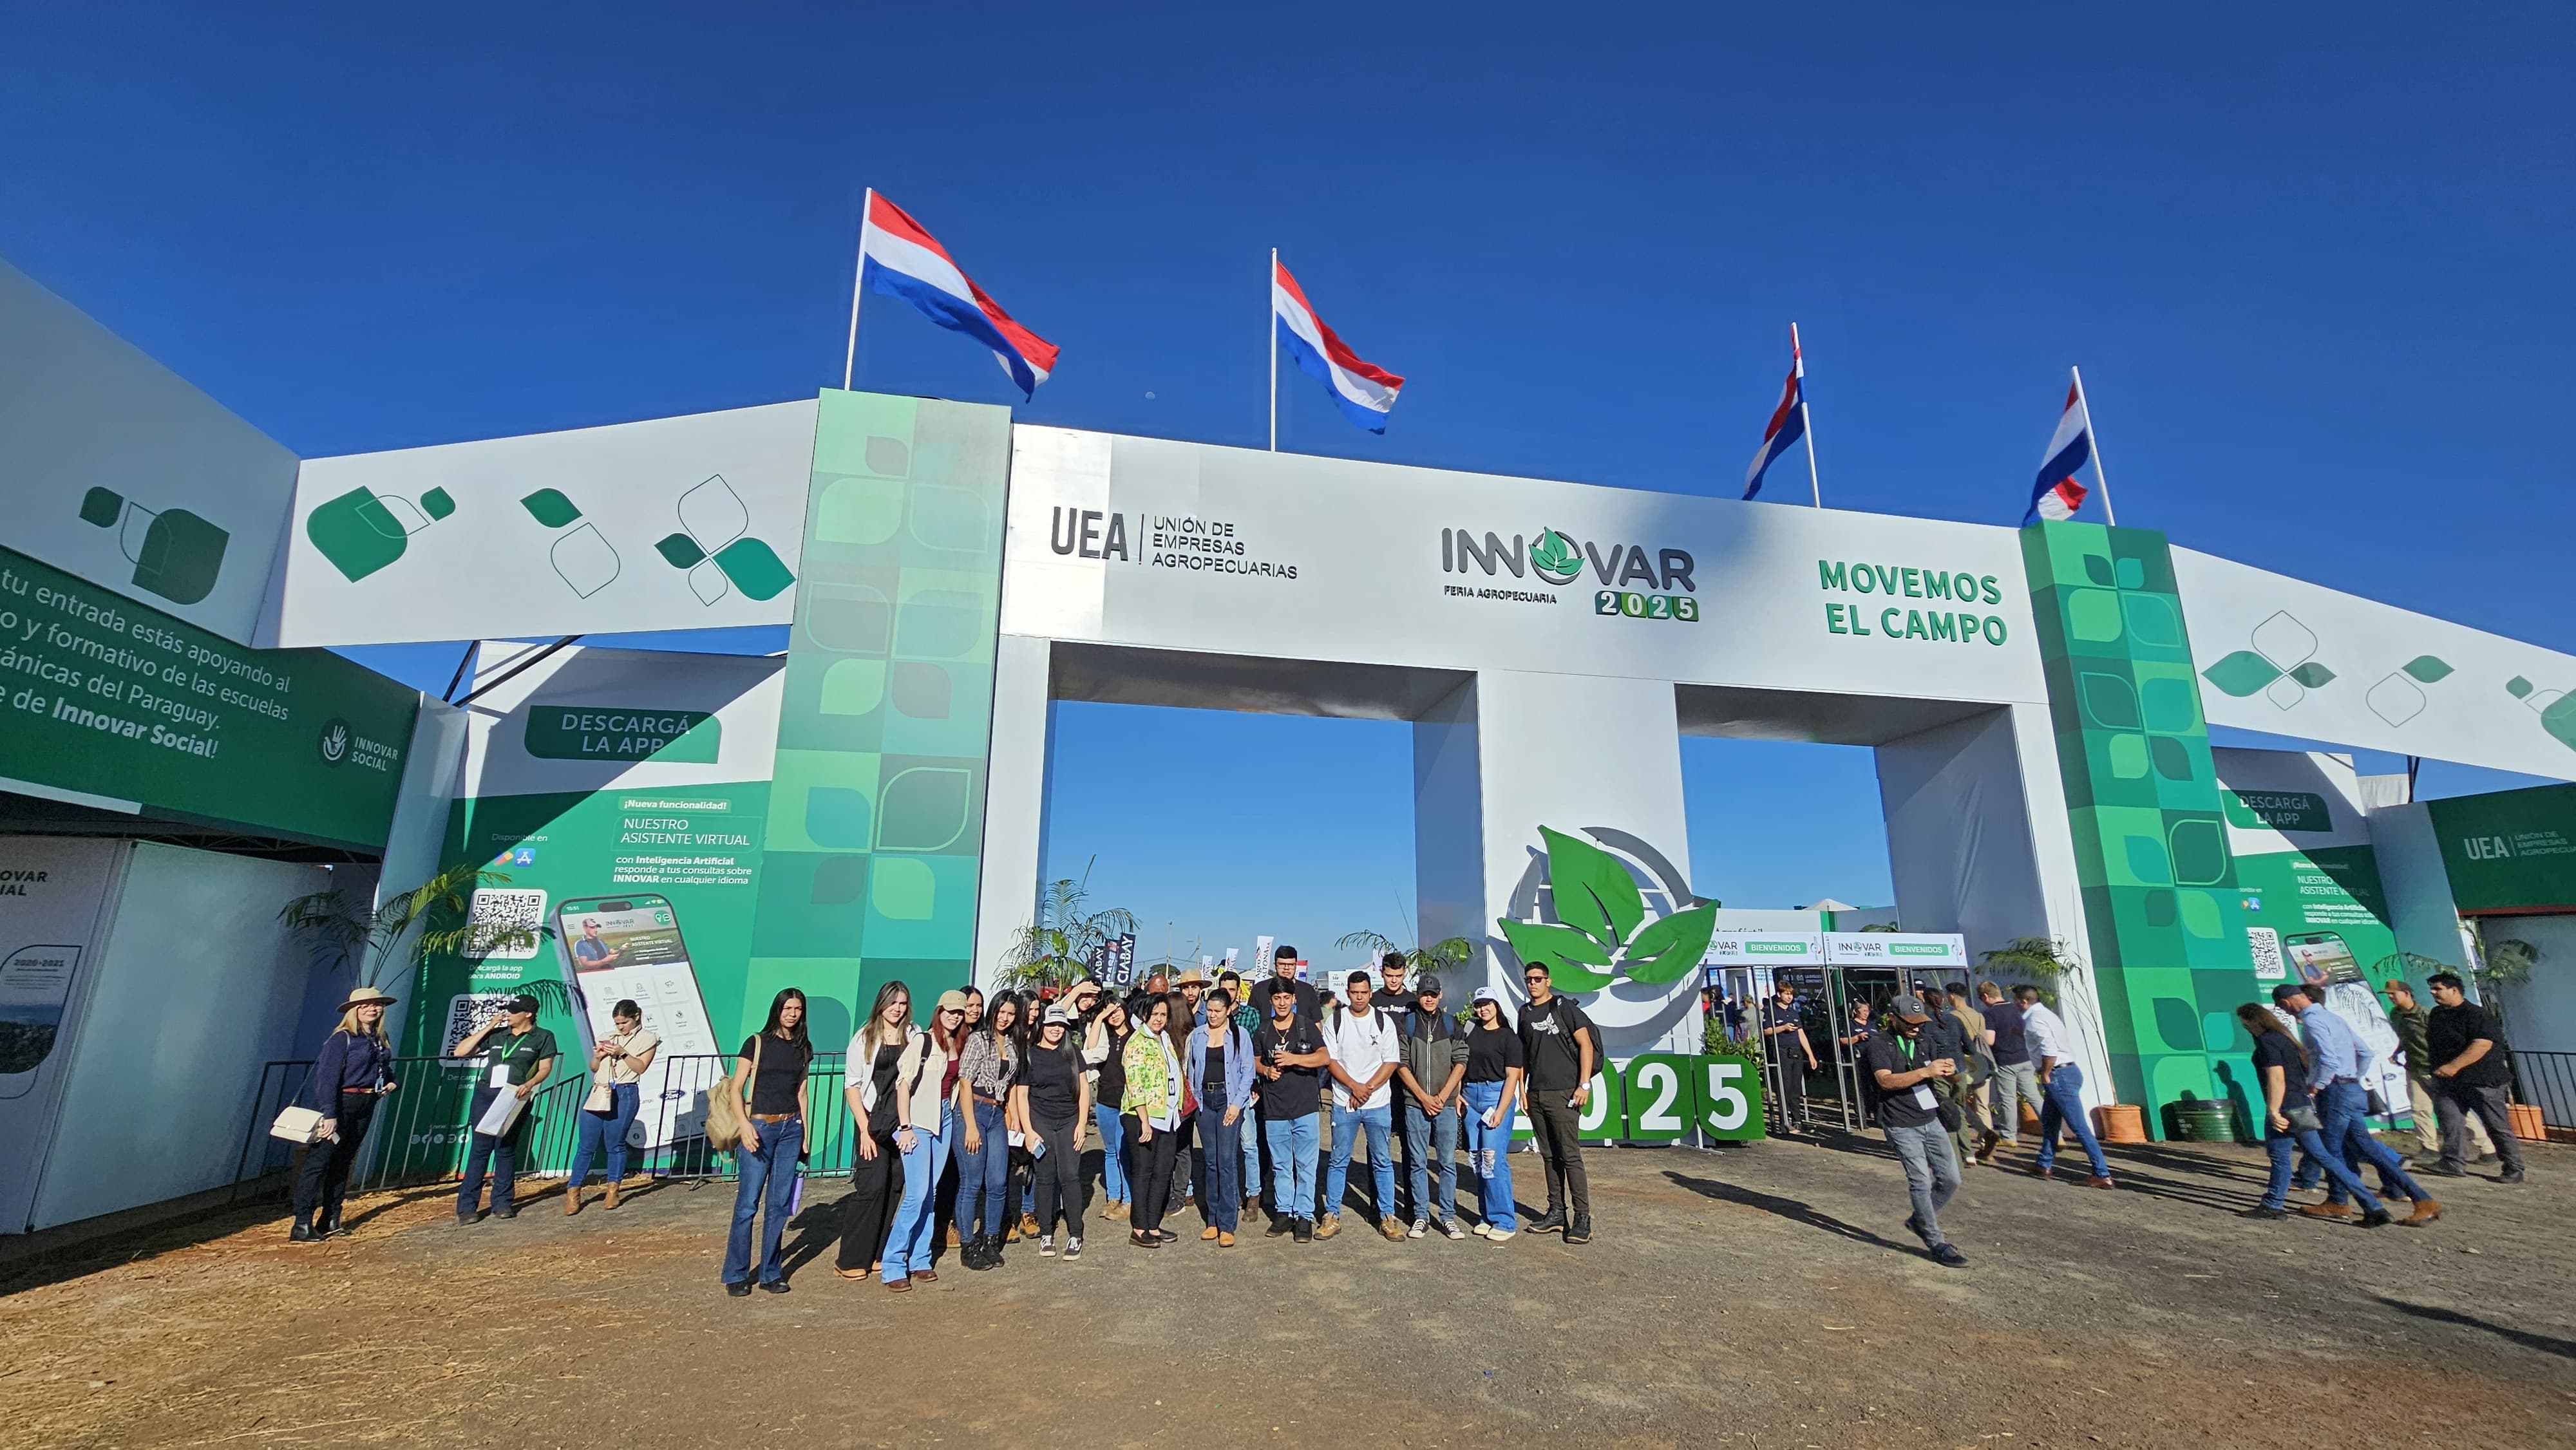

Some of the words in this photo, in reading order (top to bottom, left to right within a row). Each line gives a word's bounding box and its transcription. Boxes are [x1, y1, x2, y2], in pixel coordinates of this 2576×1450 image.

[1051, 506, 1128, 561] UEA
[1153, 516, 1206, 536] UNIÓN
[1212, 522, 1234, 537] DE
[1153, 534, 1245, 556] EMPRESAS
[1152, 552, 1298, 579] AGROPECUARIAS
[1442, 526, 1696, 592] INNOVAR
[1819, 560, 2002, 605] MOVEMOS
[1444, 585, 1474, 598] FERIA
[1477, 587, 1557, 604] AGROPECUARIA
[1600, 590, 1694, 619] 2025
[2, 569, 28, 596] tu
[36, 587, 126, 633] entrada
[132, 623, 184, 654] estás
[188, 645, 272, 686] apoyando
[276, 677, 290, 693] al
[1826, 603, 1870, 636] EL
[1881, 607, 2007, 646] CAMPO
[0, 609, 17, 628] o
[21, 619, 41, 641] y
[47, 623, 156, 676] formativo
[162, 665, 186, 686] de
[191, 672, 216, 696] las
[220, 688, 289, 720] escuelas
[0, 646, 81, 687] ánicas
[88, 675, 124, 701] del
[128, 684, 219, 731] Paraguay.
[13, 689, 46, 713] de
[52, 697, 147, 739] Innovar
[151, 724, 219, 758] Social!
[562, 714, 690, 735] DESCARGÁ
[355, 737, 398, 760] INNOVAR
[582, 736, 610, 752] LA
[618, 737, 664, 753] APP
[352, 751, 386, 771] SOCIAL
[624, 800, 658, 809] ¡Nueva
[659, 800, 726, 810] funcionalidad!
[2240, 795, 2311, 810] DESCARGÁ
[624, 818, 688, 830] NUESTRO
[2255, 812, 2273, 824] LA
[2277, 813, 2300, 825] APP
[621, 833, 692, 844] ASISTENTE
[696, 834, 750, 845] VIRTUAL
[2463, 836, 2510, 860] UEA
[614, 866, 657, 874] responde
[636, 856, 691, 865] Inteligencia
[693, 857, 734, 865] Artificial
[613, 874, 659, 883] INNOVAR
[674, 876, 716, 885] cualquier
[718, 876, 748, 884] idioma
[2297, 876, 2334, 884] NUESTRO
[2300, 886, 2339, 895] ASISTENTE
[1710, 941, 1738, 950] OVAR
[1839, 941, 1882, 952] INNOVAR
[1117, 936, 1133, 983] CIABAY
